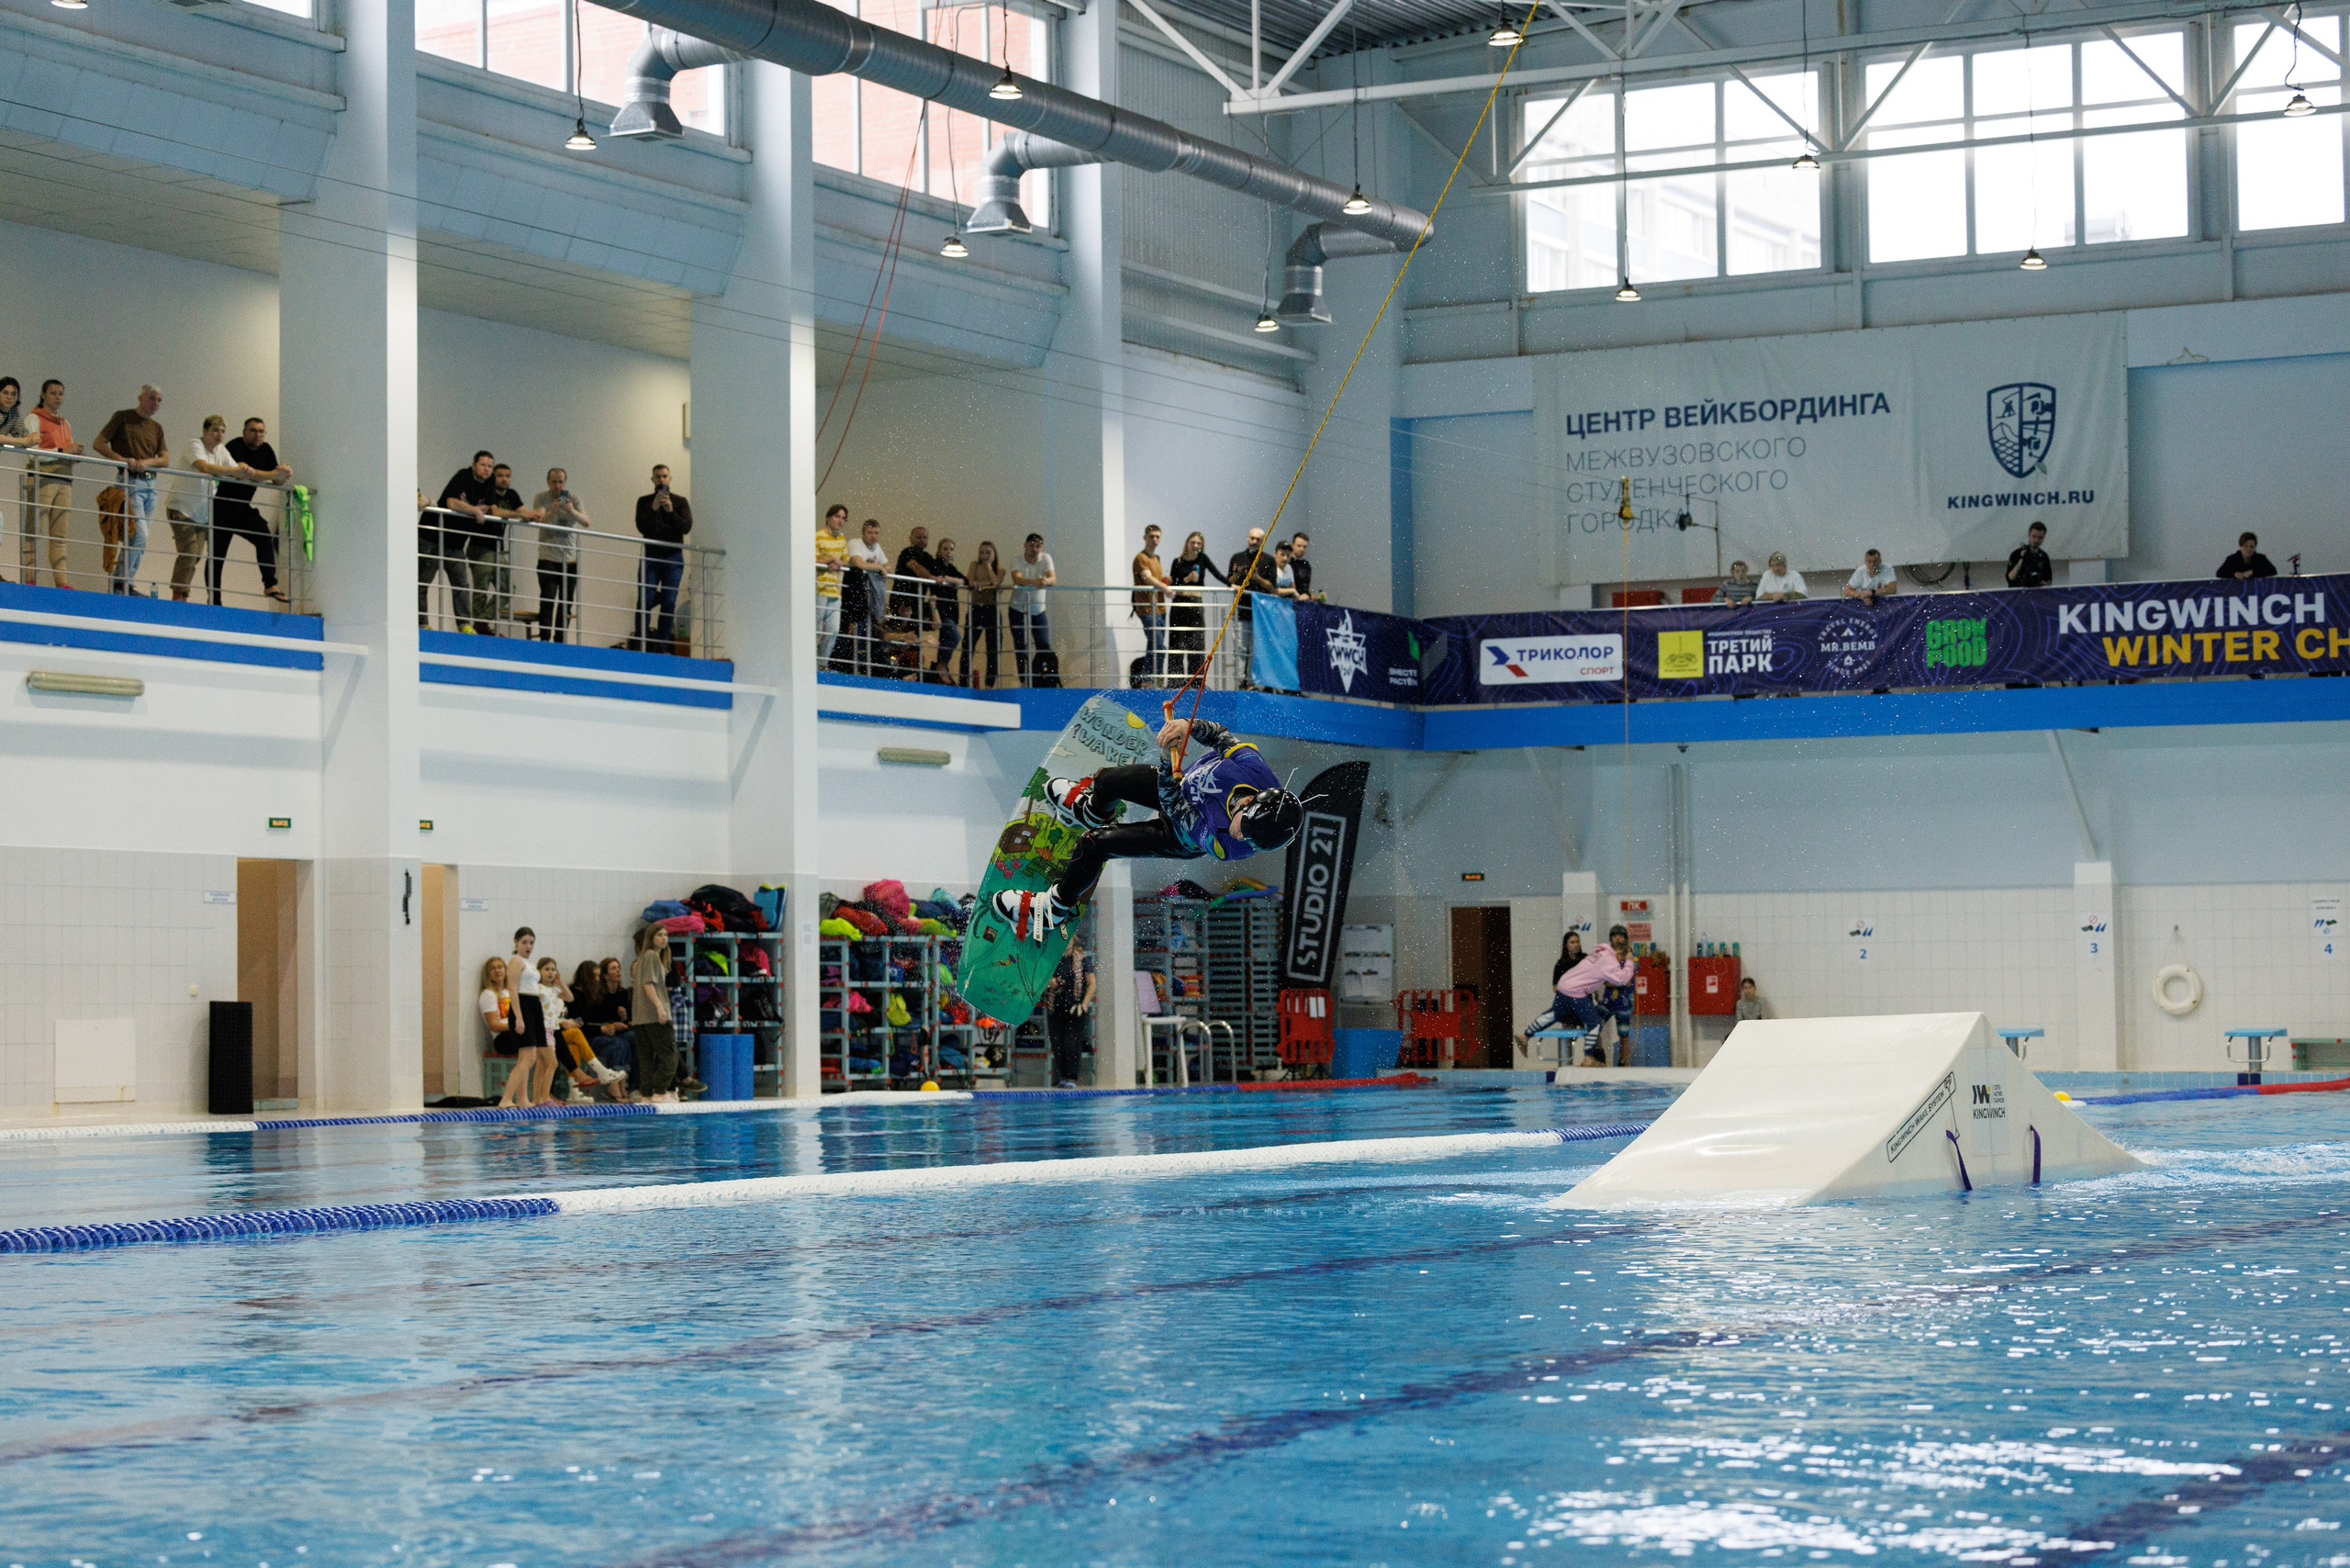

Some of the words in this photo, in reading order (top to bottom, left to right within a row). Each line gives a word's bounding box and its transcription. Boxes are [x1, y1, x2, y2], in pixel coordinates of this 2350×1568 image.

[1567, 409, 1655, 440] ЦЕНТР
[1663, 392, 1891, 429] ВЕЙКБОРДИНГА
[1567, 436, 1807, 472] МЕЖВУЗОВСКОГО
[1947, 489, 2095, 509] KINGWINCH.RU
[2058, 592, 2325, 635] KINGWINCH
[1707, 634, 1773, 655] ТРЕТИЙ
[1926, 617, 1987, 650] GROW
[1516, 645, 1615, 662] ТРИКОЛОР
[1820, 641, 1875, 653] MR.BEMB
[1926, 636, 1987, 668] FOOD
[2102, 630, 2281, 667] WINTER
[2295, 627, 2350, 659] CH
[1580, 666, 1615, 676] СПОРТ
[1708, 654, 1774, 674] ПАРК
[1080, 705, 1149, 756] WONDER
[1310, 826, 1335, 857] 21
[1296, 863, 1329, 966] STUDIO
[1859, 948, 1868, 959] 2
[2090, 942, 2098, 954] 3
[2323, 943, 2333, 954] 4
[1890, 1123, 1915, 1154] KINGWINCH
[1914, 1109, 1929, 1126] WAKE
[1928, 1089, 1944, 1113] SYSTEM
[1972, 1107, 2006, 1120] KINGWINCH
